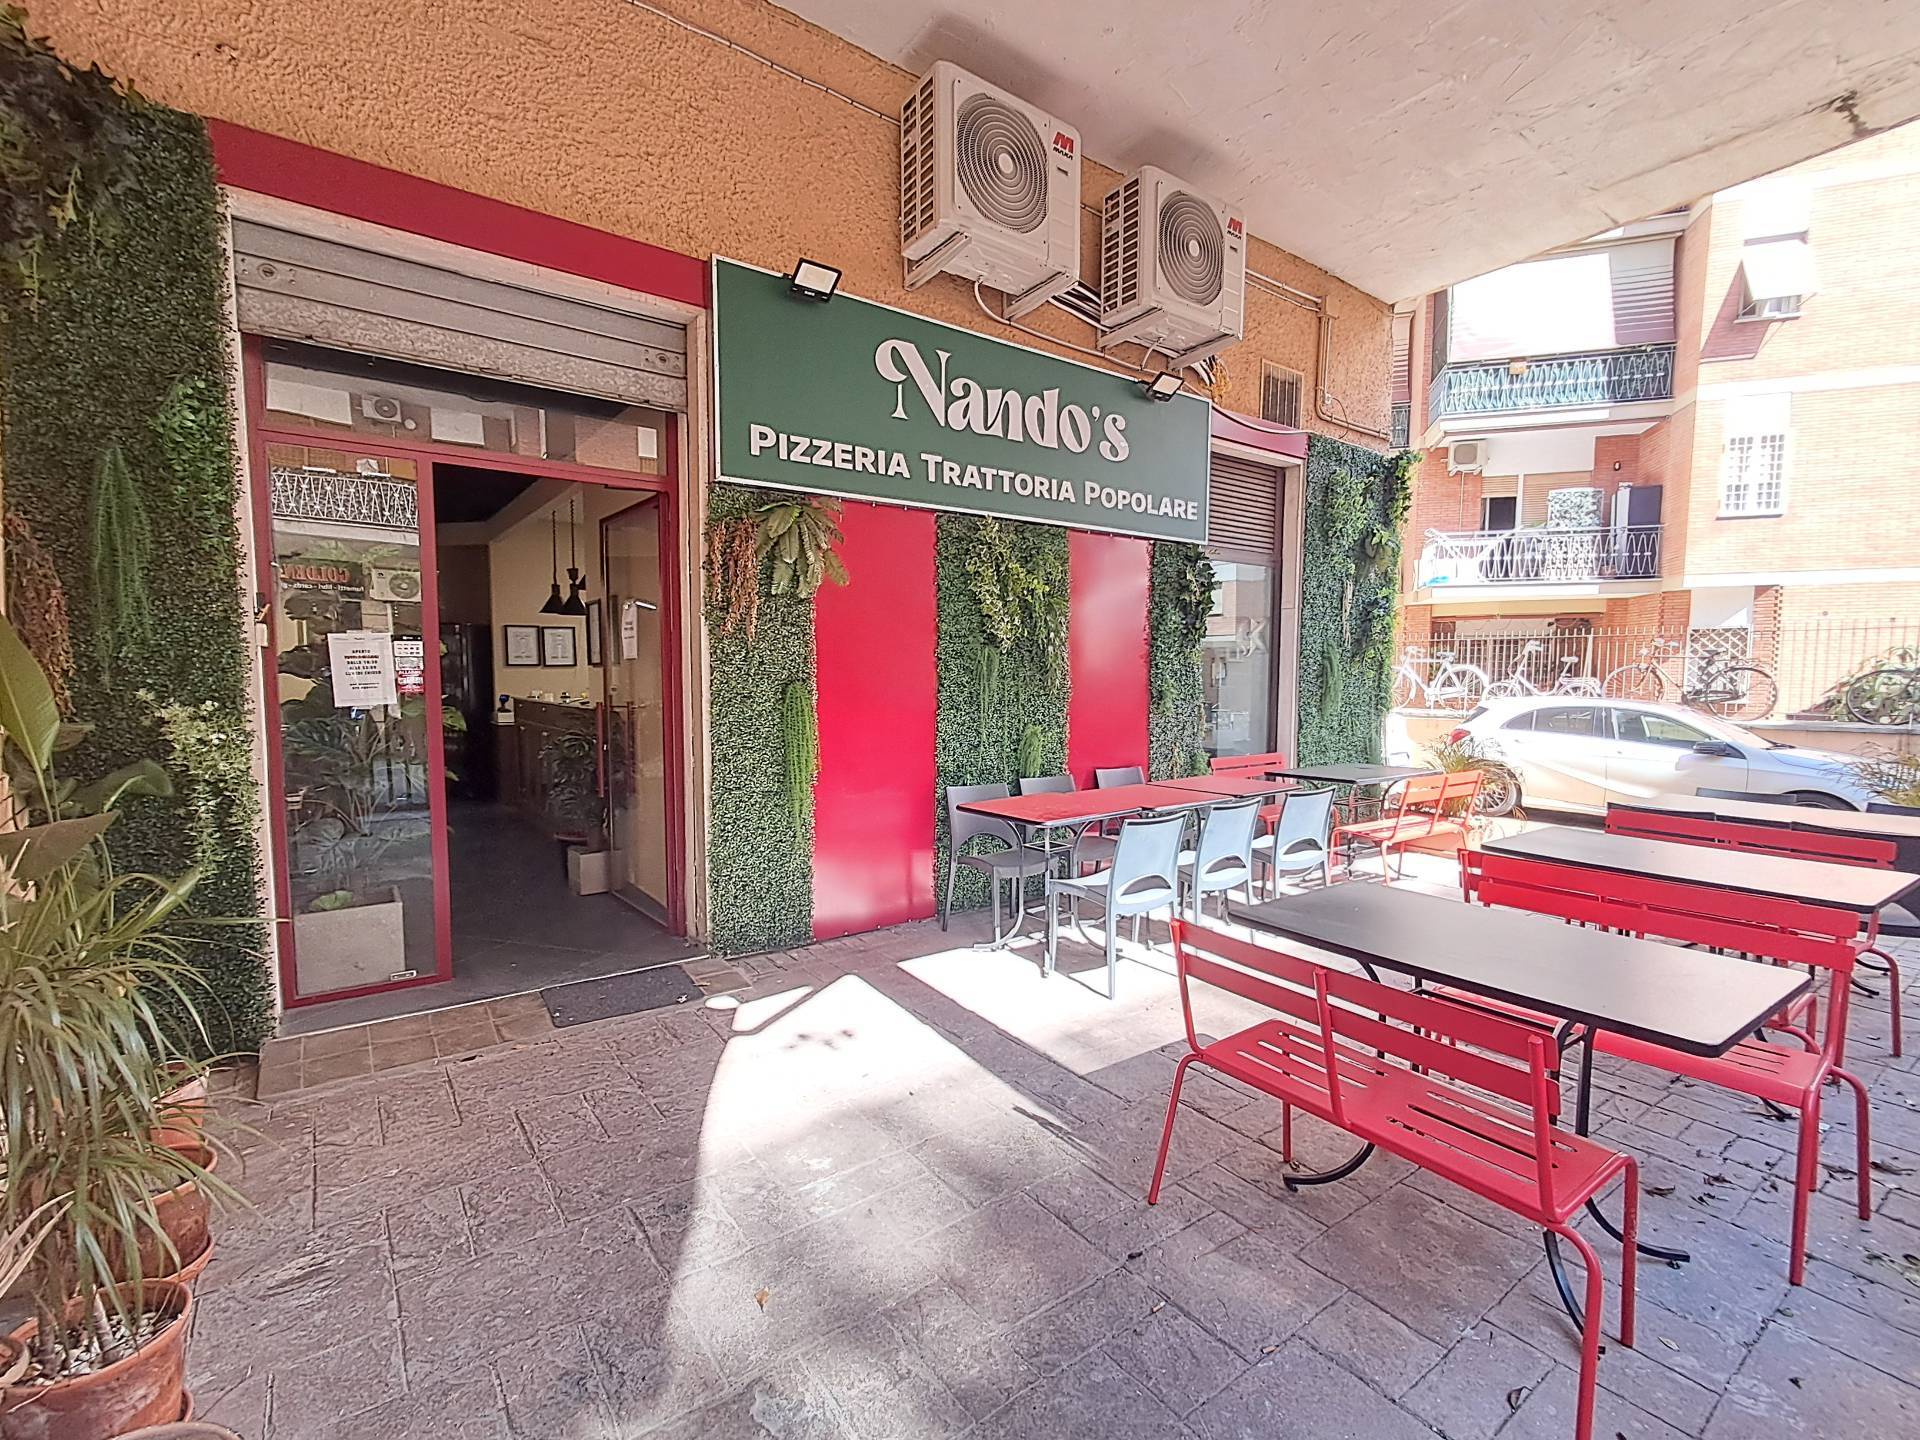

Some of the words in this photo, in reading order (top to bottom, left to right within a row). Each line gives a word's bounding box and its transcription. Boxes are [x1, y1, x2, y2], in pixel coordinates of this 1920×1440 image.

[875, 338, 1130, 462] Nando's
[749, 424, 910, 479] PIZZERIA
[921, 452, 1076, 504] TRATTORIA
[1084, 481, 1198, 521] POPOLARE
